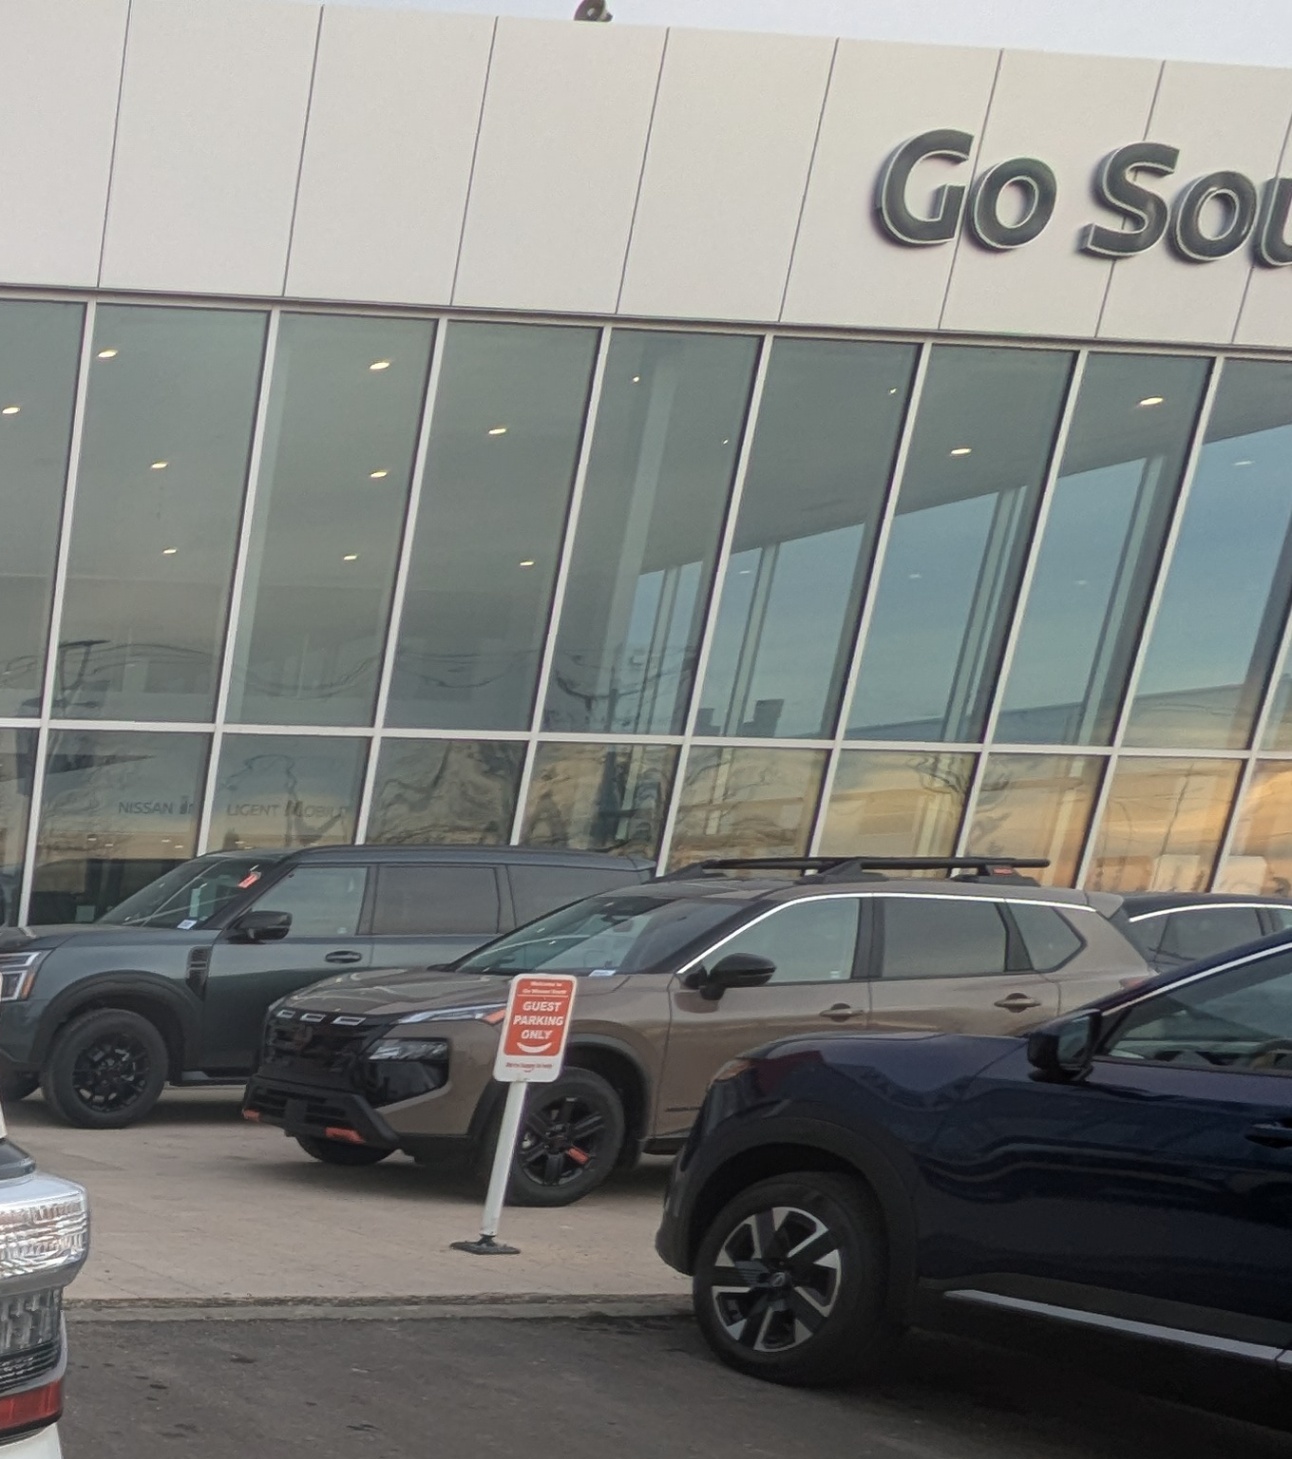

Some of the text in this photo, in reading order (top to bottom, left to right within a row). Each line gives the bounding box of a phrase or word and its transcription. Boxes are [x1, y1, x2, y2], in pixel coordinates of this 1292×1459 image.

[876, 129, 1057, 250] Go
[118, 802, 174, 815] NISSAN
[523, 1001, 561, 1012] GUEST
[513, 1015, 564, 1026] PARKING
[521, 1030, 553, 1040] ONLY
